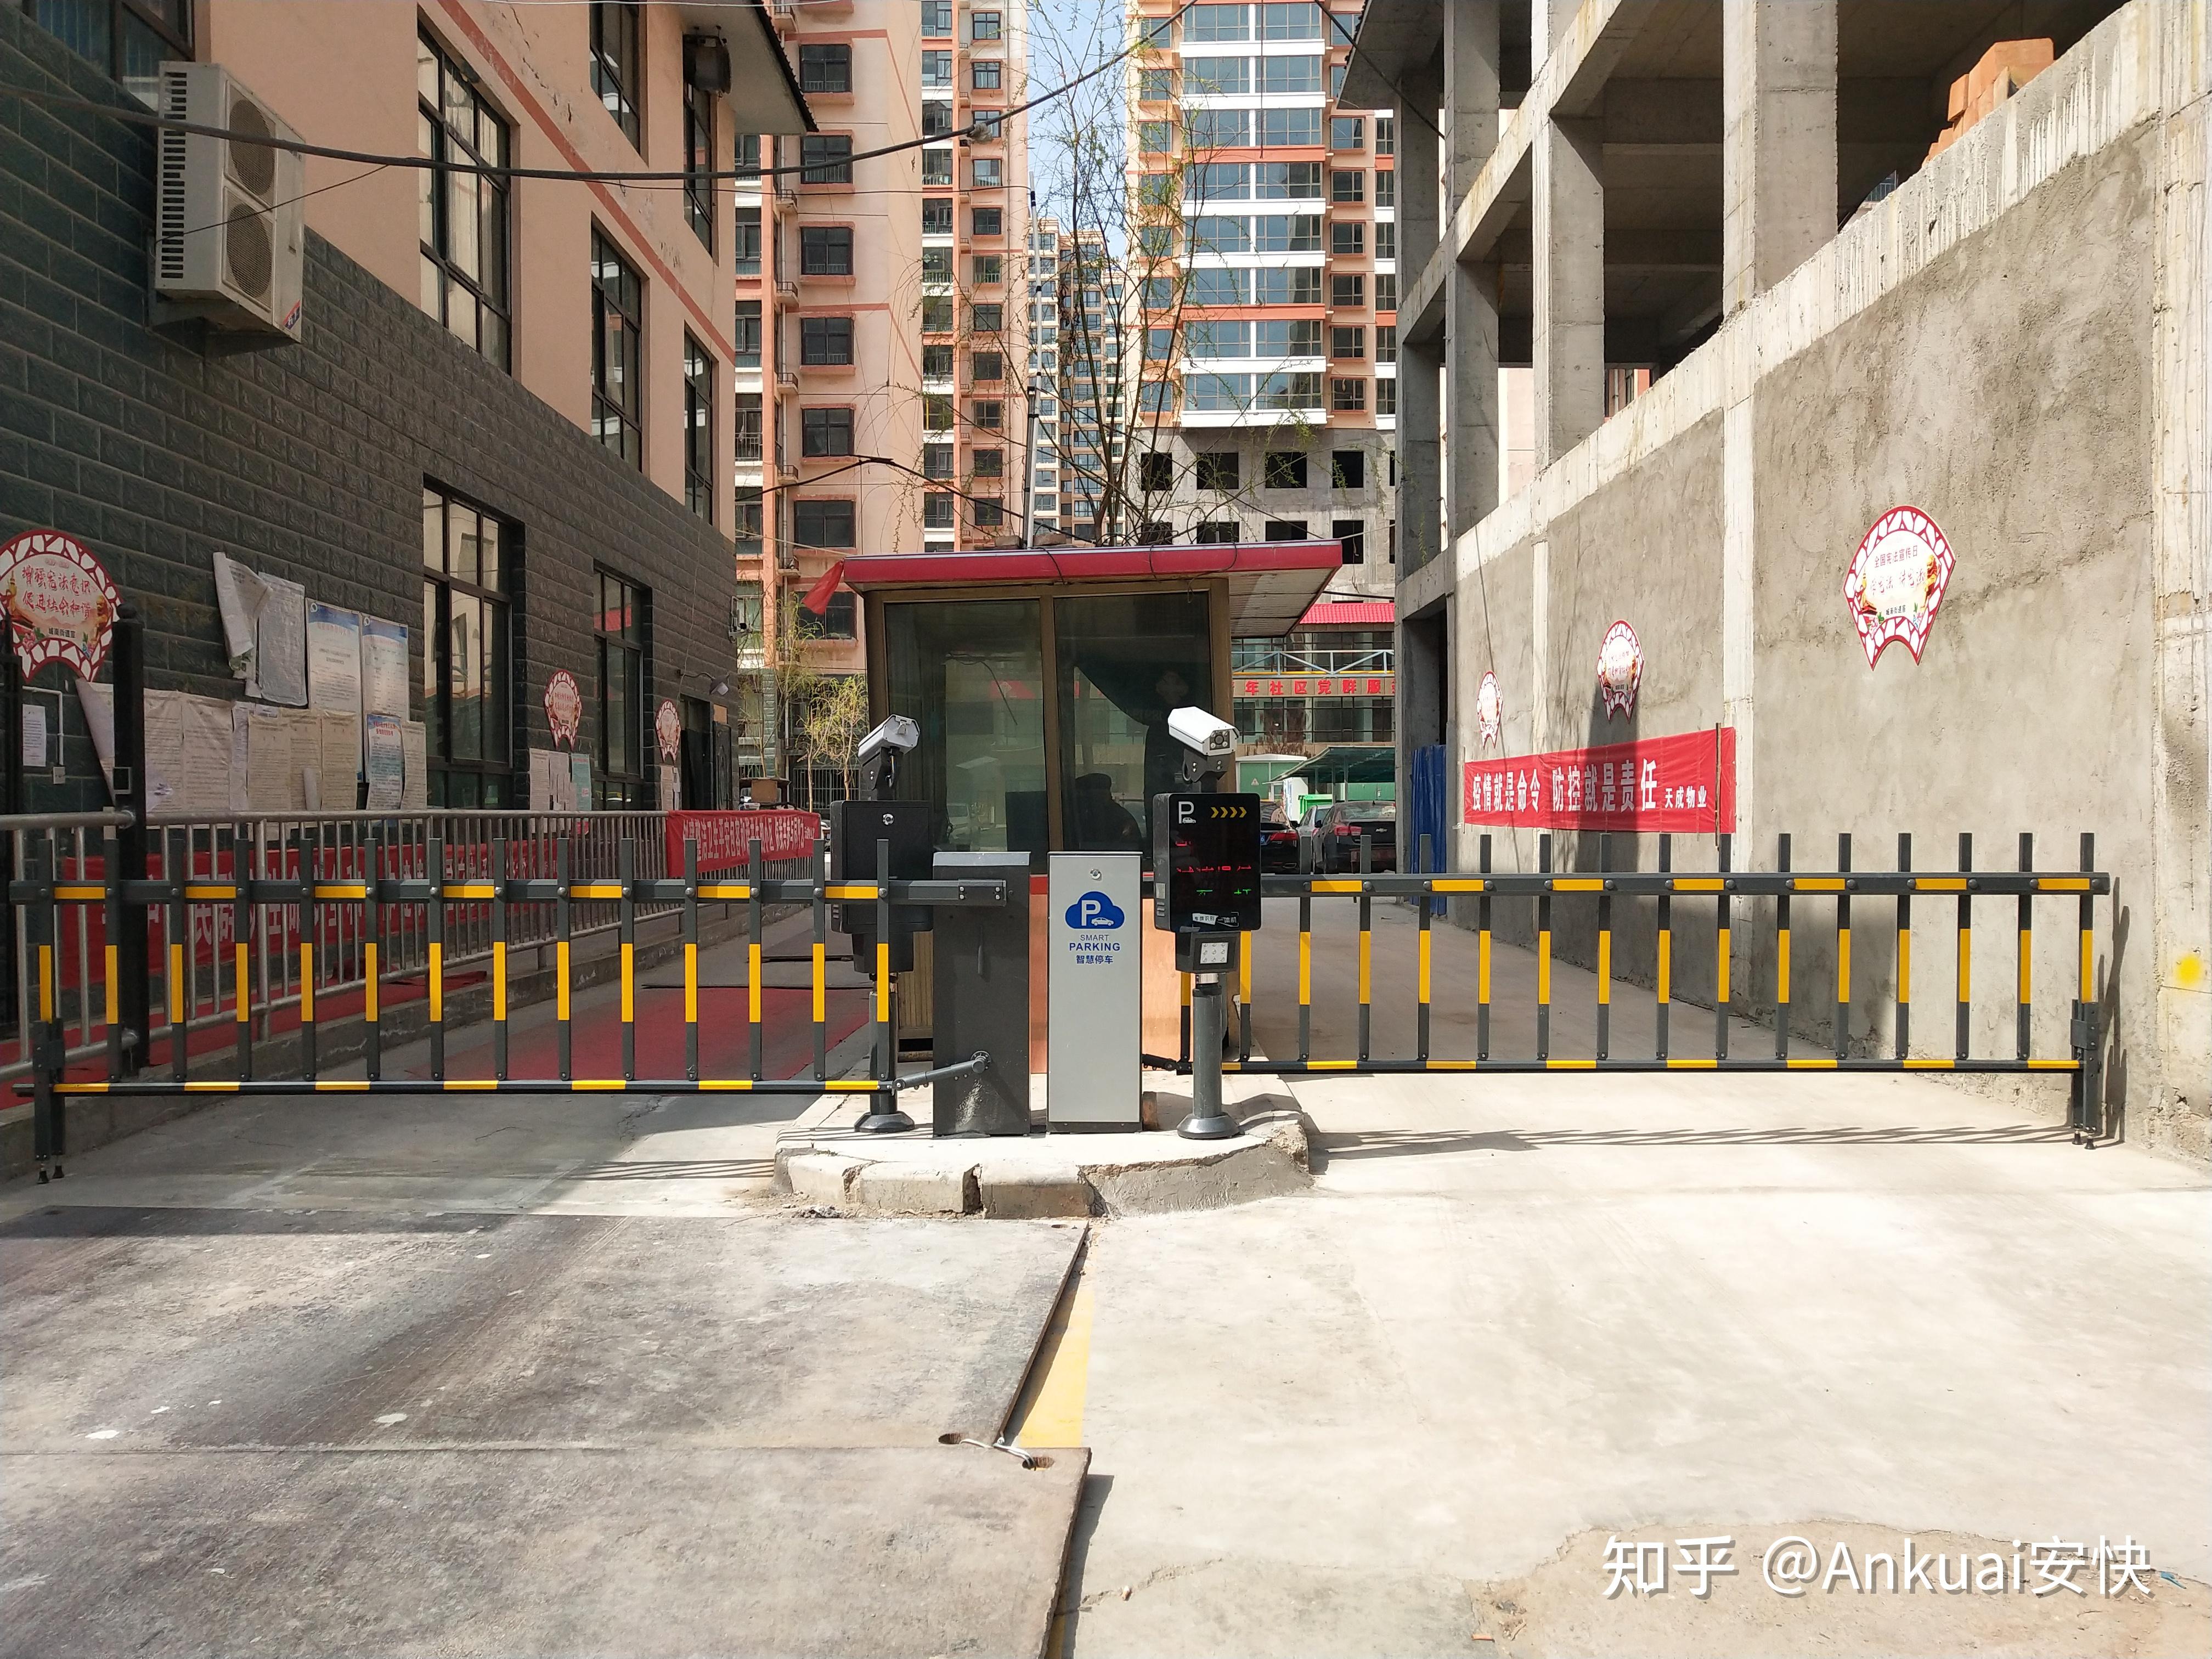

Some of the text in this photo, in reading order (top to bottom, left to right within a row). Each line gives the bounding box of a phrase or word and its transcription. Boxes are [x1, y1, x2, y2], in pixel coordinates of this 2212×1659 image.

[1875, 545, 1917, 568] 全国宪法宣传日
[22, 565, 91, 596] 增强宪法意识
[22, 590, 91, 620] 促进社会和谐
[48, 627, 76, 639] 城南街道宣
[1232, 679, 1395, 696] 年社区党群服
[1472, 758, 1707, 813] 疫情就是命令 防控就是责任 天成物业
[1178, 801, 1194, 823] P
[1081, 900, 1101, 926] P
[1069, 943, 1120, 951] PARKING
[1076, 955, 1114, 964] 智慧停车
